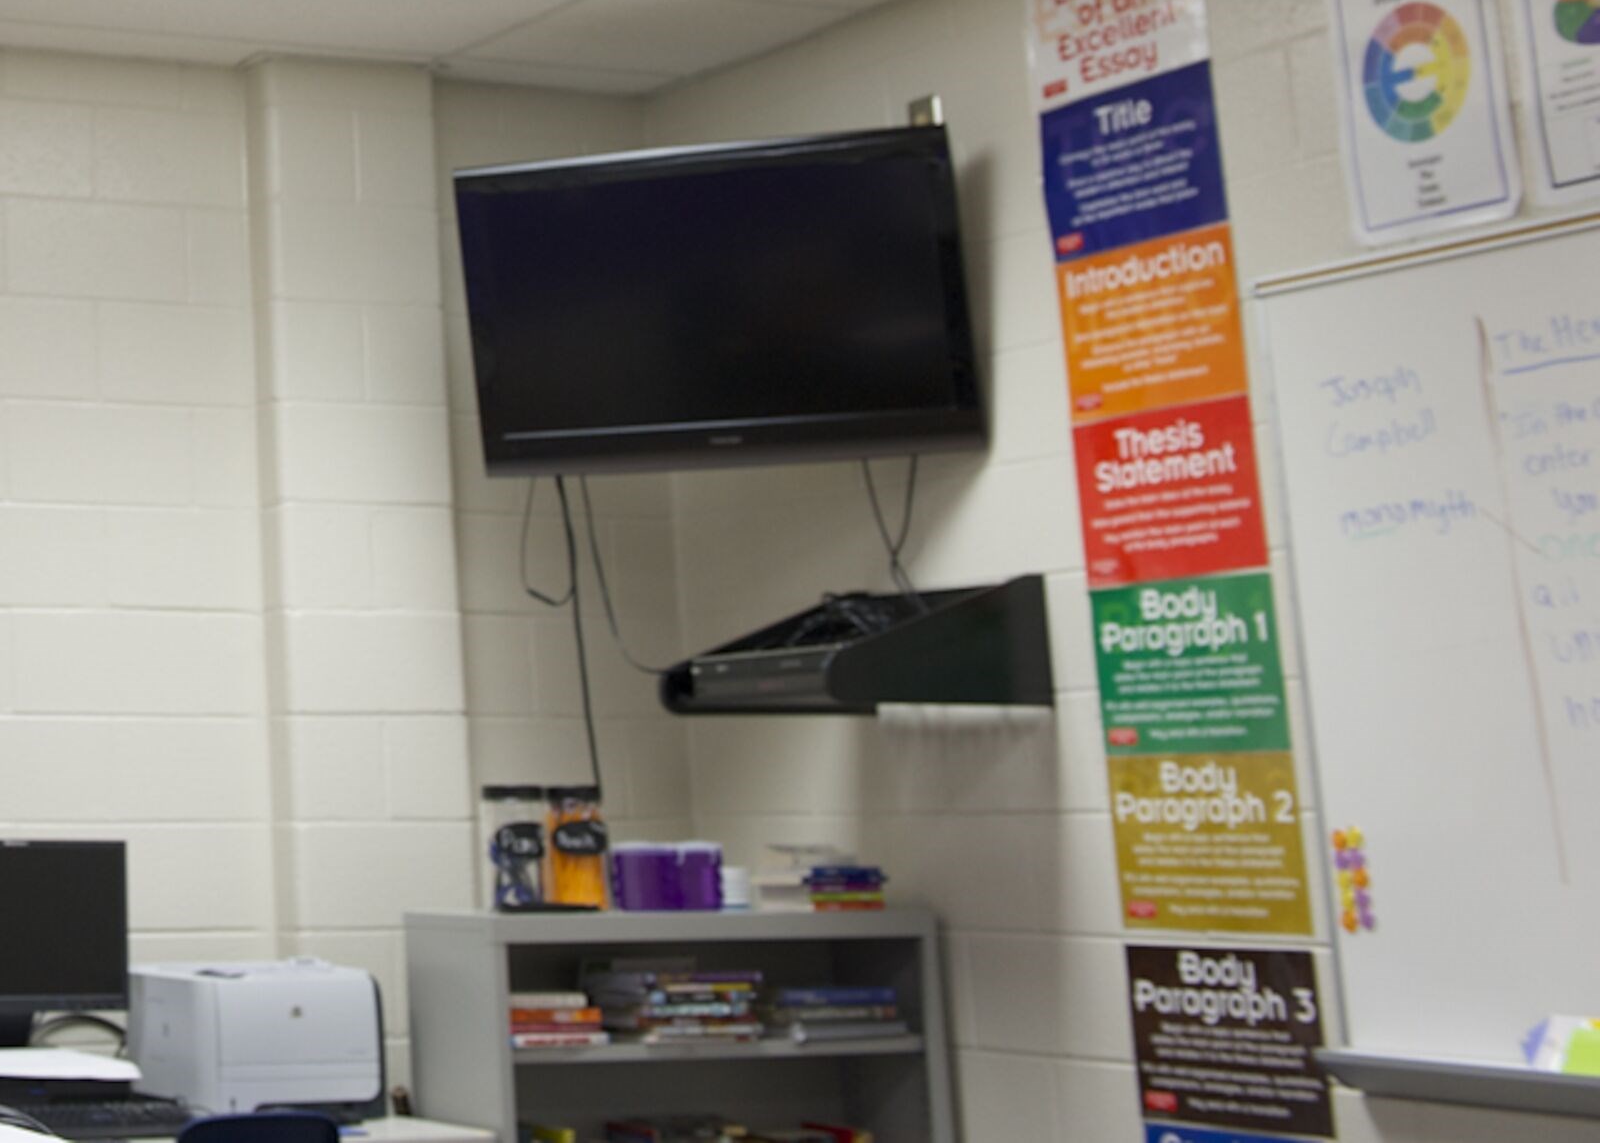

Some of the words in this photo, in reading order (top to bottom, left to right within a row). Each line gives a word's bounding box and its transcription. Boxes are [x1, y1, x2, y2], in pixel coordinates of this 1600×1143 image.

[1058, 4, 1177, 61] Excellent
[1079, 42, 1158, 83] Essay
[1094, 98, 1153, 136] Title
[1065, 241, 1227, 299] Introduction
[1113, 418, 1204, 458] Thesis
[1095, 443, 1237, 493] Statement
[1139, 587, 1218, 623] Body
[1101, 613, 1248, 656] Paragraph
[1254, 611, 1269, 642] 1
[1159, 760, 1237, 798] Body
[1115, 792, 1267, 831] Paragraph
[1272, 789, 1296, 824] 2
[1176, 950, 1257, 990] Body
[1133, 977, 1288, 1025] Paragraph
[1292, 988, 1317, 1024] 3
